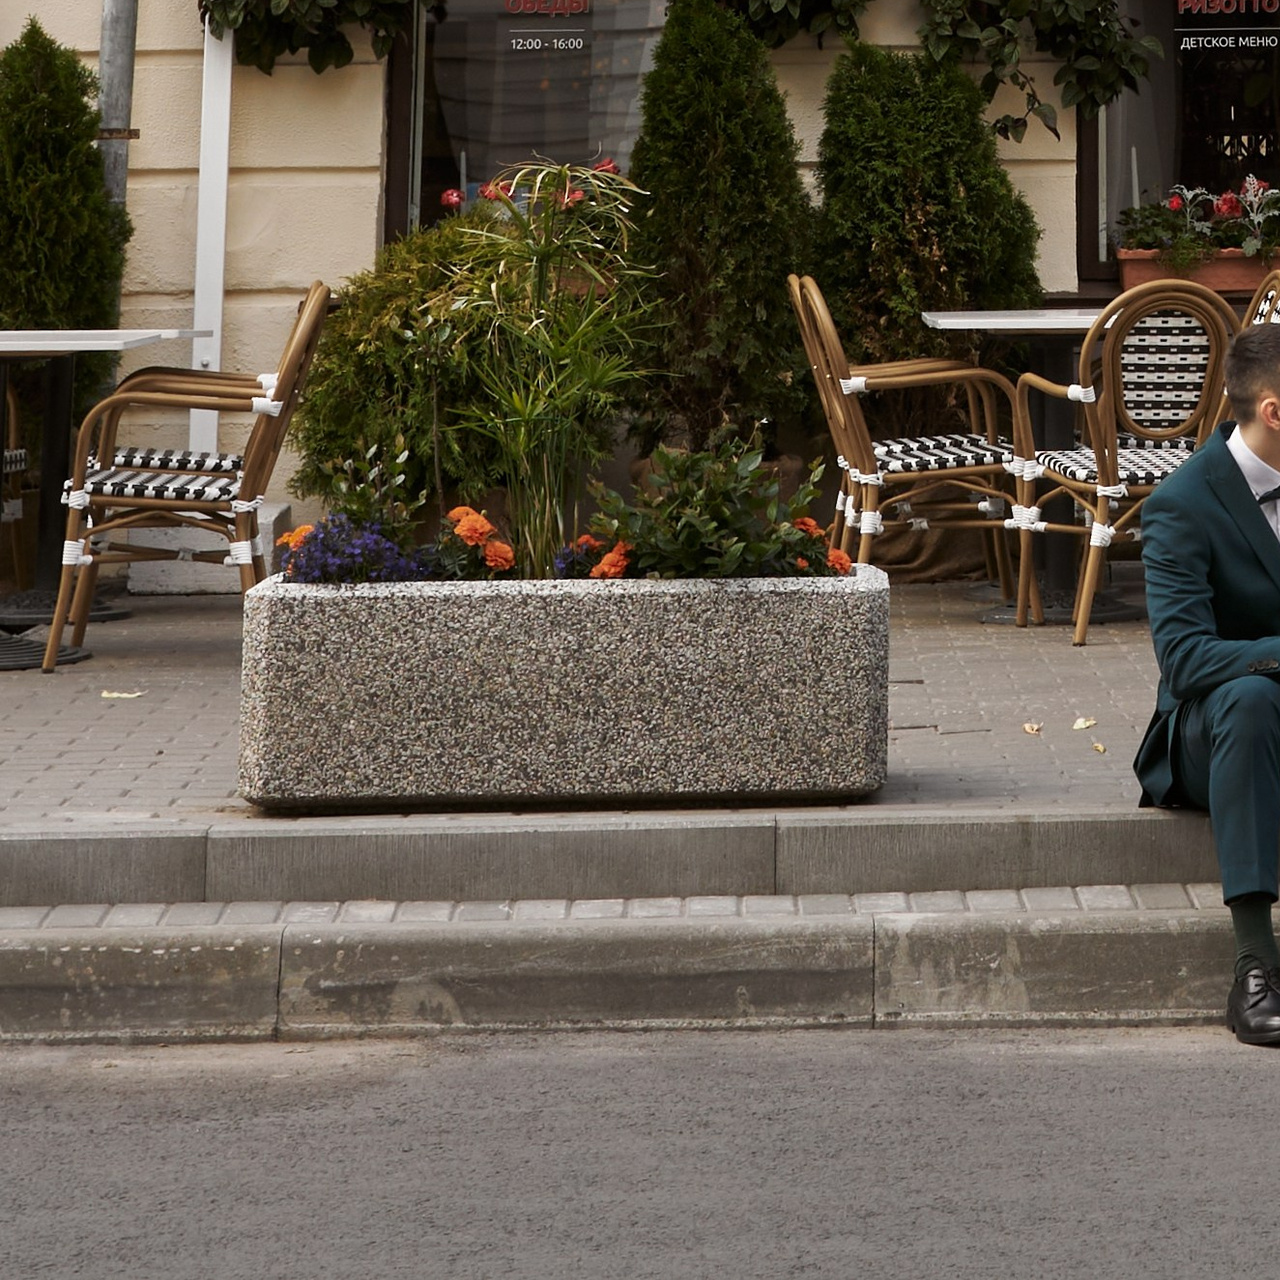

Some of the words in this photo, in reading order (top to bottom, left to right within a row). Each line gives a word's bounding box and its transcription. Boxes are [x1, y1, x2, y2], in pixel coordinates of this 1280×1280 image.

[511, 38, 542, 50] 12:00
[552, 38, 584, 50] 16:00
[1180, 36, 1236, 50] ДЕТСКОЕ
[1238, 36, 1279, 48] МЕНЮ
